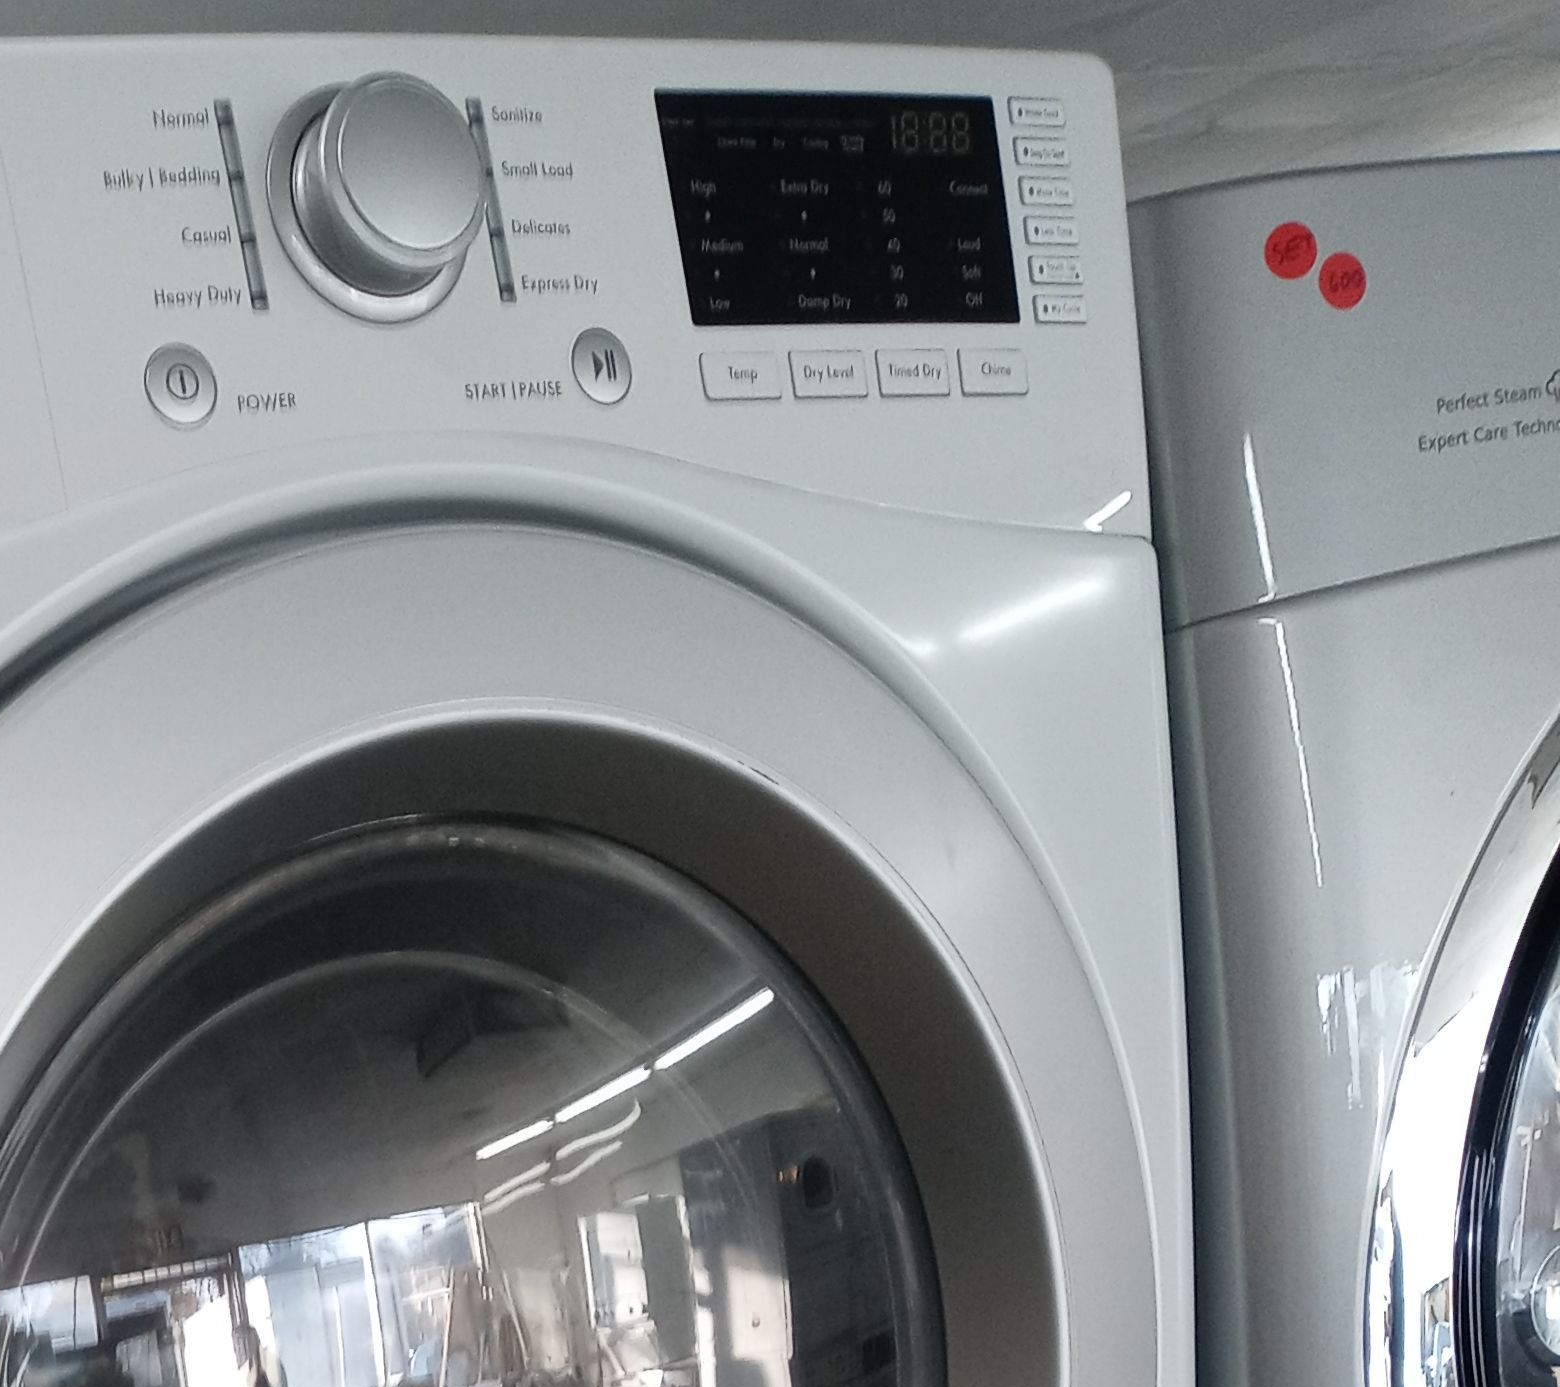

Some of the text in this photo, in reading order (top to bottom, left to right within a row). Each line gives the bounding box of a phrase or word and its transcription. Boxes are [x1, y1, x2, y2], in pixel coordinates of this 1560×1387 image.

[153, 108, 209, 128] Normal
[492, 106, 542, 123] Sanitize
[104, 166, 220, 189] Bulky Bedding
[501, 162, 573, 178] Small Load
[691, 180, 716, 196] High
[810, 181, 829, 196] Dry
[181, 226, 231, 245] Casual
[511, 219, 570, 236] Delicates
[701, 238, 744, 252] Medium
[789, 238, 829, 251] Normal
[521, 275, 598, 294] Express Dry
[153, 287, 241, 308] Heavy Duty
[728, 365, 758, 383] Temp
[803, 364, 854, 381] Dry Level
[889, 364, 941, 381] Timed Dry
[981, 364, 1011, 377] Chime
[465, 381, 562, 399] START PAUSE
[237, 392, 296, 411] POWER
[1436, 386, 1542, 415] Perfect Steam
[1418, 429, 1469, 453] Expert
[1473, 426, 1508, 443] Care
